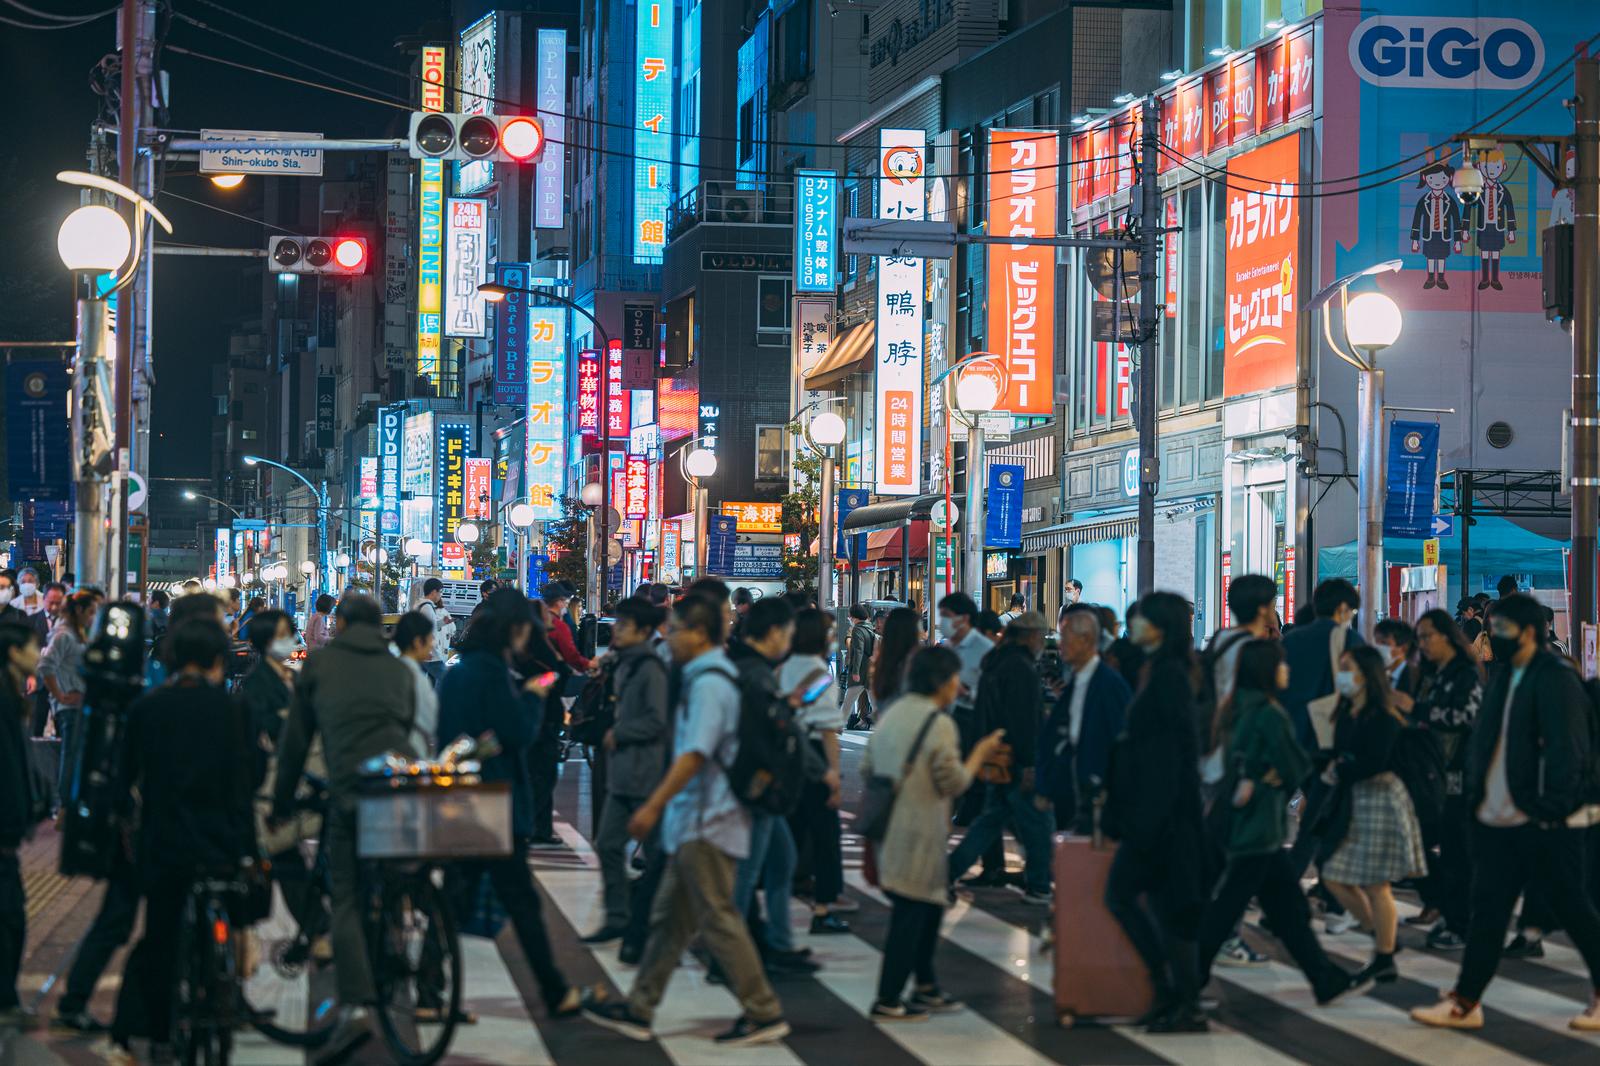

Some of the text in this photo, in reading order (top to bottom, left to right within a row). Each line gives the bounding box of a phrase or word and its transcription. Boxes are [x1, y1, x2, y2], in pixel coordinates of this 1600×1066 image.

[1358, 25, 1536, 80] GiGO
[544, 51, 558, 128] PLAZA
[1212, 86, 1254, 132] BIG CHO
[222, 156, 302, 169] Shin-okubo Sta.
[543, 143, 557, 220] HOTEL
[422, 191, 441, 286] MARINE
[454, 215, 480, 228] OPEN
[457, 203, 479, 216] 24h
[804, 177, 814, 285] 03-6279-1530
[815, 177, 829, 286] カンナム整体院
[419, 336, 439, 348] ホテル
[505, 292, 519, 380] Cafe & Bar
[1010, 260, 1039, 407] ビッグエコー
[1229, 283, 1294, 344] ビッグエコー
[529, 319, 556, 508] カラオケ館
[580, 360, 599, 428] 中華物産
[699, 405, 720, 418] XU
[890, 397, 909, 479] 24時間営業
[468, 466, 477, 509] PLAZA
